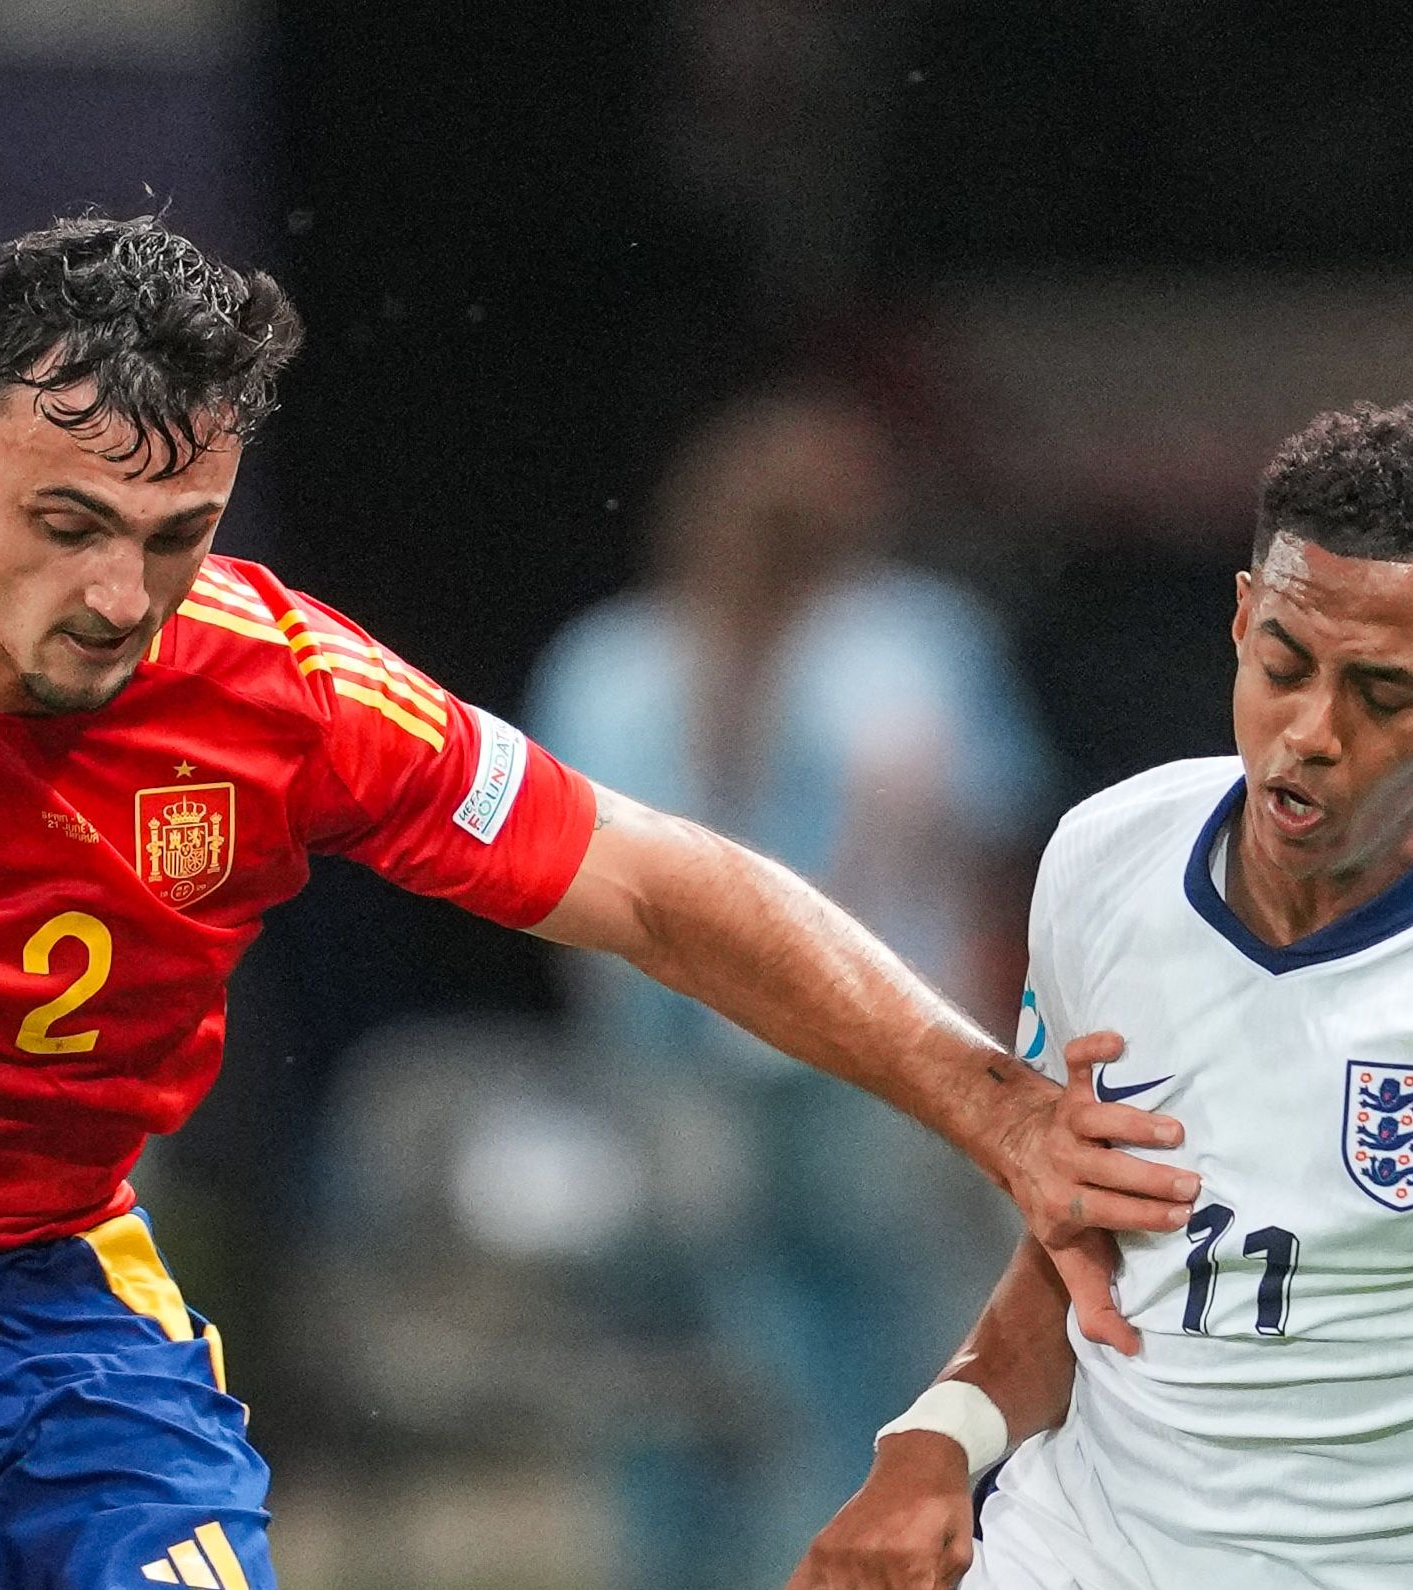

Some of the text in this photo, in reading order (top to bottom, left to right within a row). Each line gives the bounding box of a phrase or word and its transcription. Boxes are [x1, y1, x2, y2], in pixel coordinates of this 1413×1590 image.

[47, 820, 59, 829] 21
[62, 823, 87, 833] JUNE
[459, 789, 481, 821] UEFA
[467, 721, 511, 831] FOUNDATI
[15, 911, 113, 1055] 2
[1182, 1202, 1300, 1336] 11
